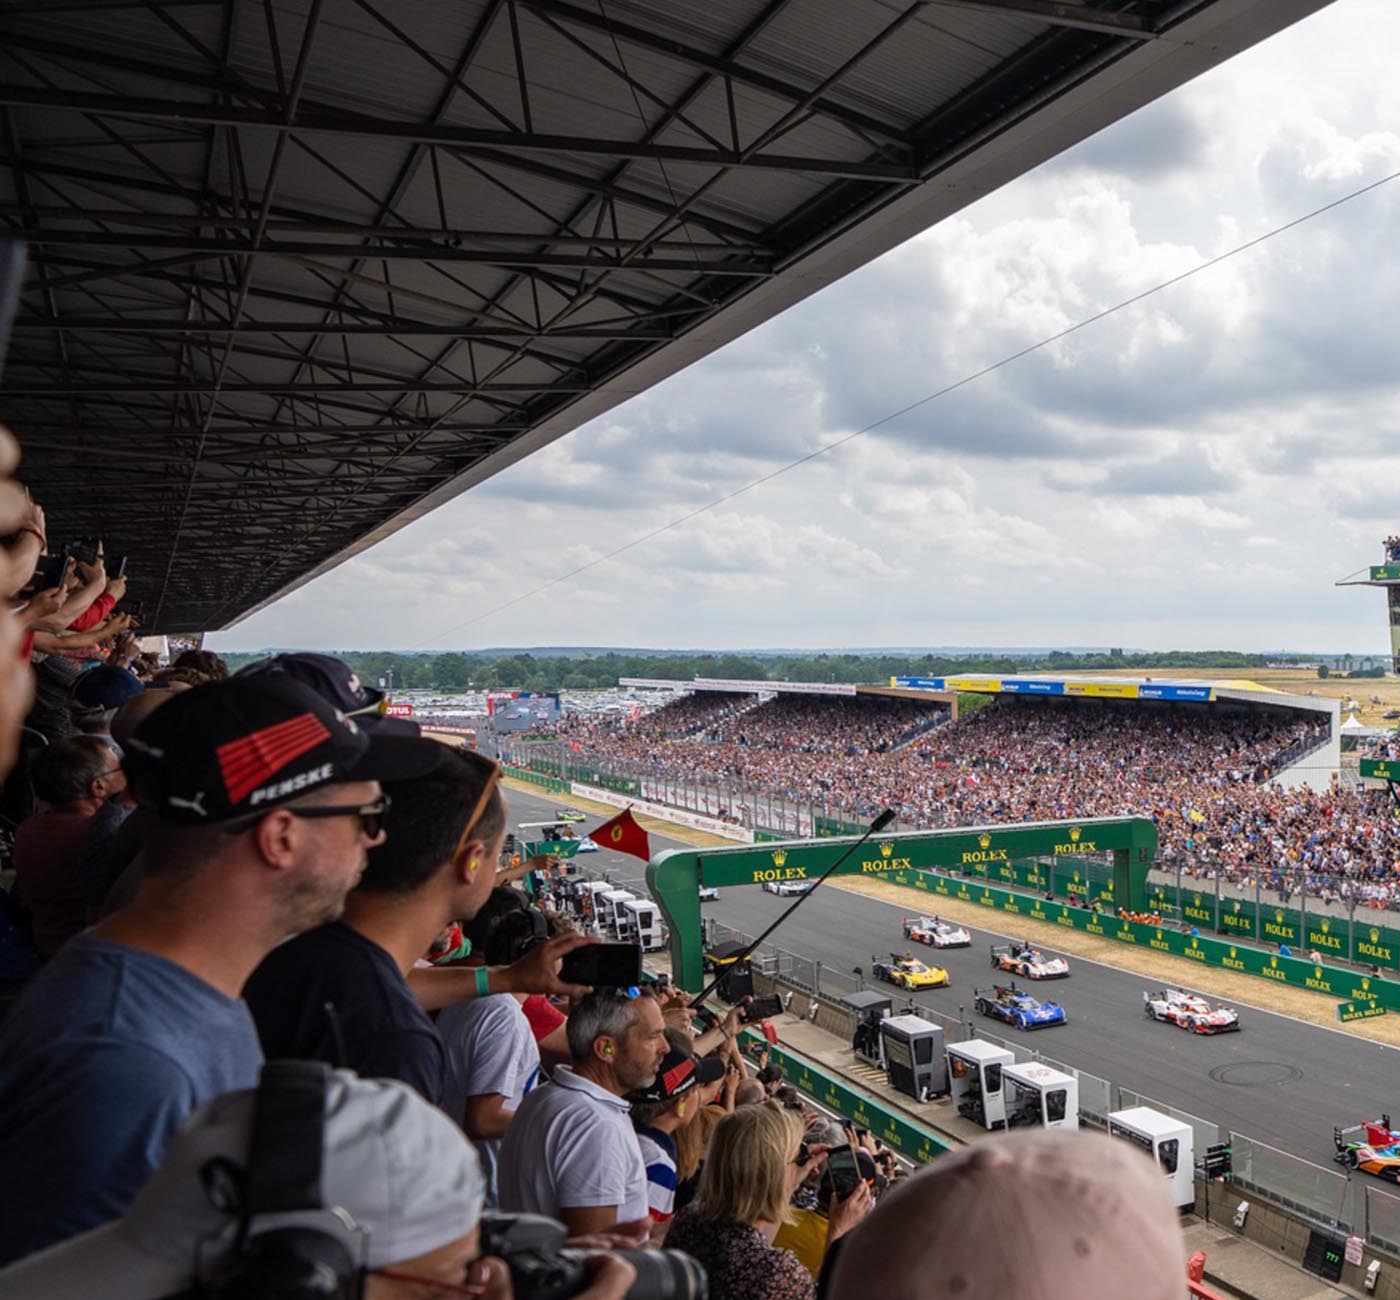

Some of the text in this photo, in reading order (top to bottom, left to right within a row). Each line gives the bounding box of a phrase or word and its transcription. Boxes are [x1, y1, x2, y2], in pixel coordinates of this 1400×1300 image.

[250, 762, 333, 805] PENSKE
[1054, 842, 1096, 855] ROLEX
[962, 849, 1008, 863] ROLEX
[862, 858, 911, 872] ROLEX
[753, 867, 806, 883] ROLEX
[1265, 923, 1294, 938] ROLEX
[1310, 932, 1341, 949] ROLEX
[1184, 947, 1205, 960] ROLEX
[1358, 943, 1391, 960] ROLEX
[1222, 957, 1244, 970] ROLEX
[1263, 967, 1286, 980] ROLEX
[1306, 978, 1331, 990] ROLEX
